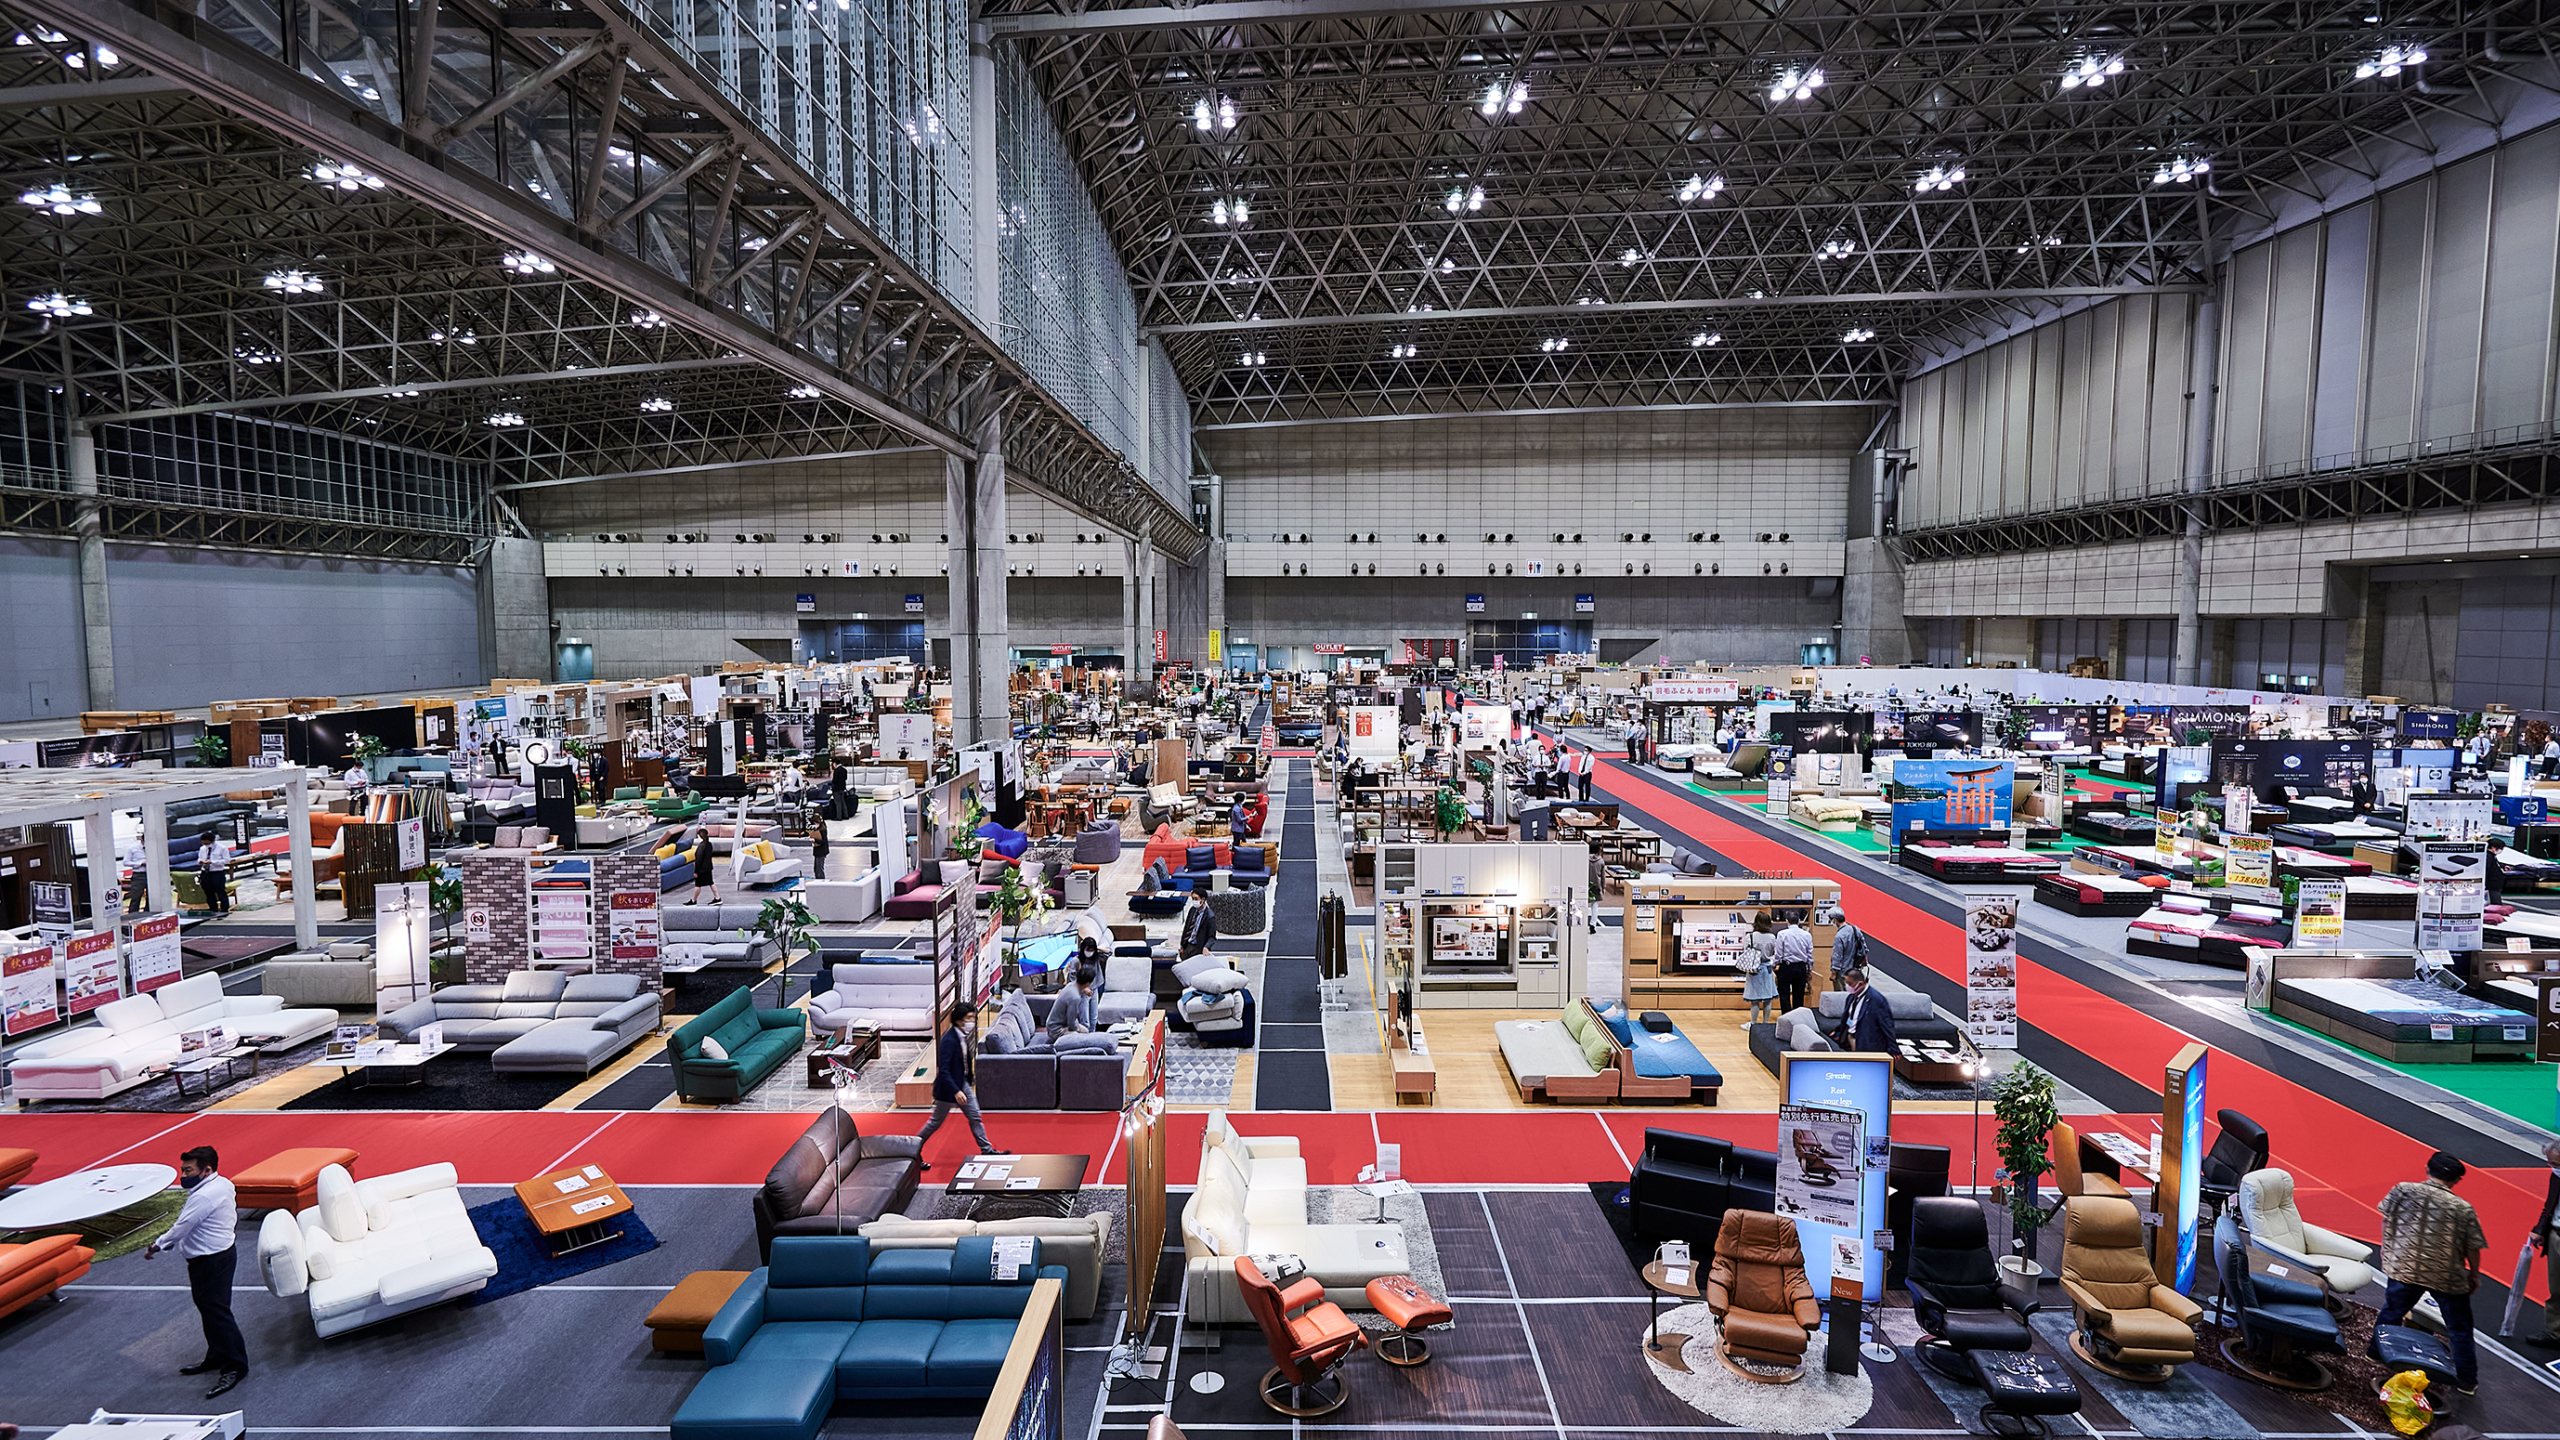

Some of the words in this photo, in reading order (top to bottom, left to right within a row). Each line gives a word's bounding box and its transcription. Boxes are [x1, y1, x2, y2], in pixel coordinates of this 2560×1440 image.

[2177, 711, 2243, 723] SIMMONS
[2410, 722, 2449, 730] SIMMONS
[1770, 750, 1790, 758] SALE
[1830, 1086, 1846, 1095] Rest
[1823, 1098, 1839, 1107] your
[1839, 1097, 1853, 1107] legs
[1780, 1111, 1861, 1124] 特別先行販売商品
[1833, 1285, 1853, 1297] New
